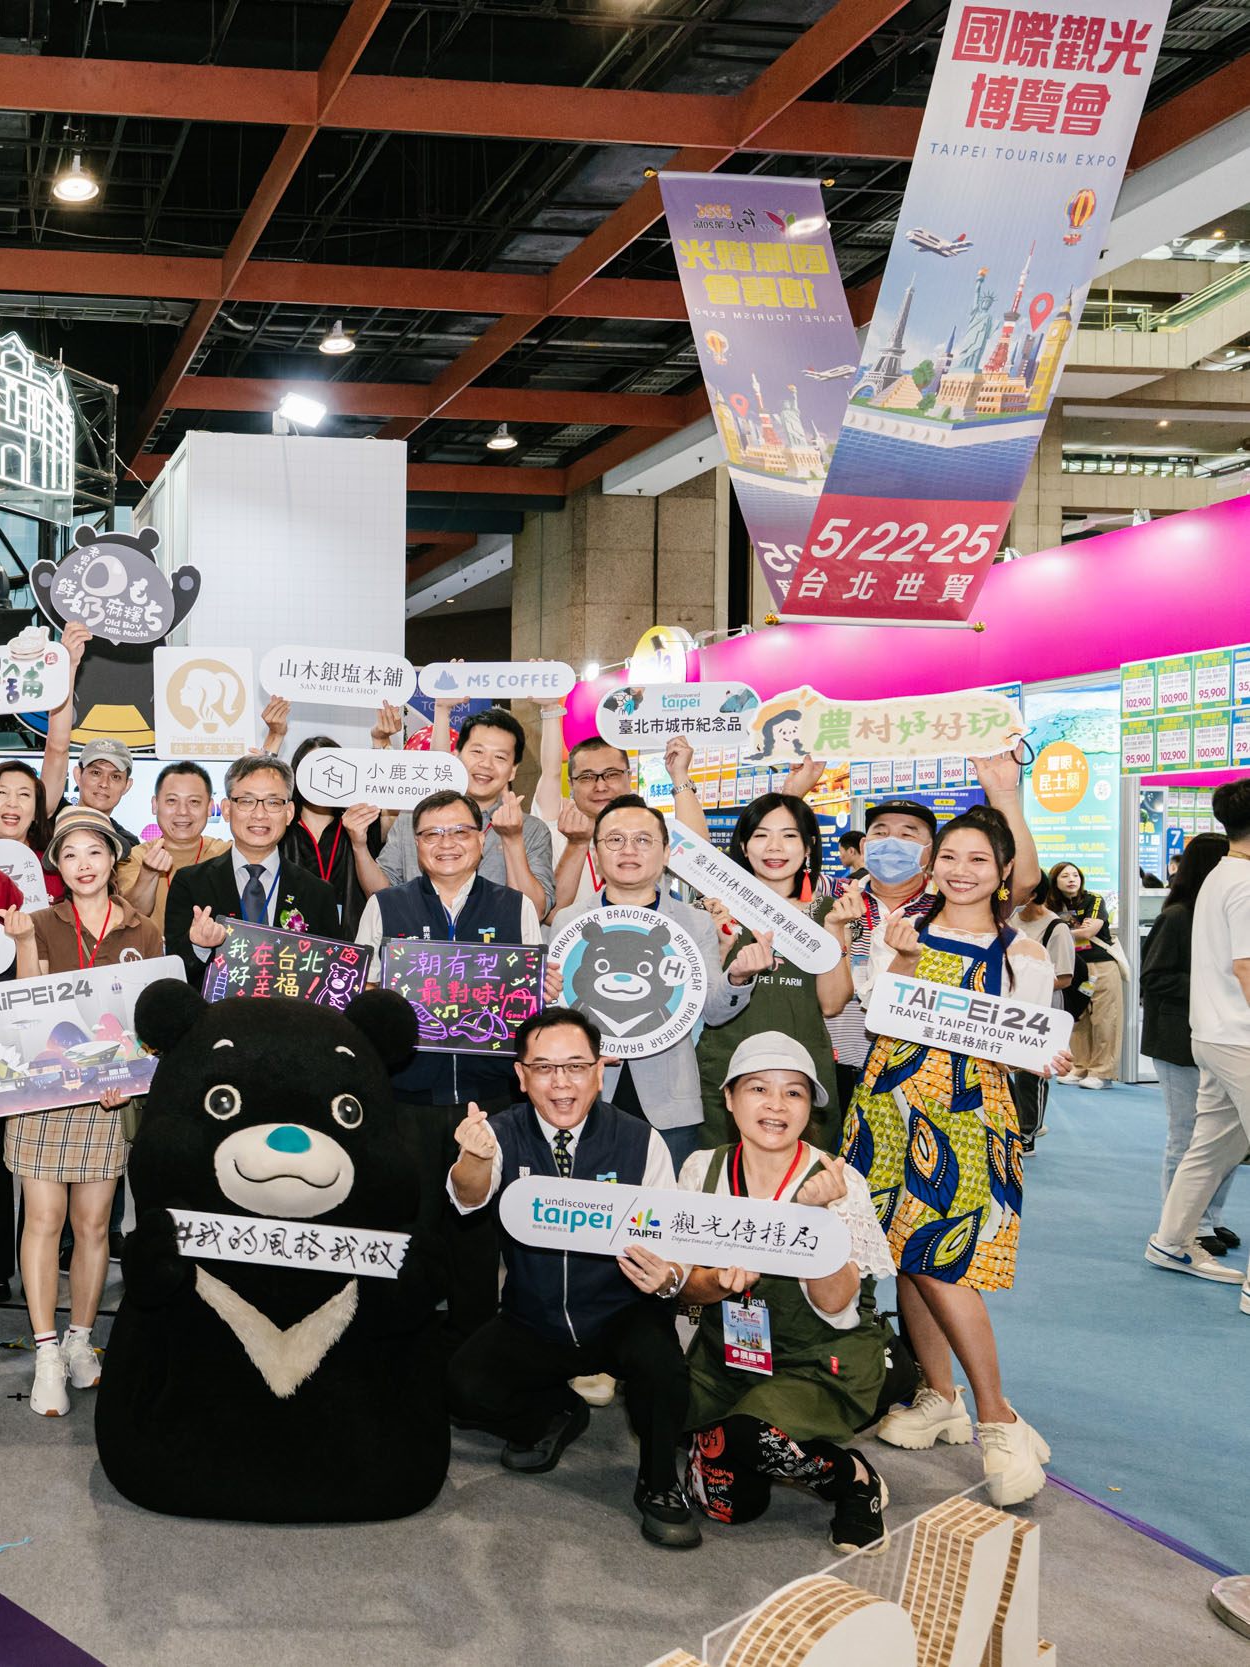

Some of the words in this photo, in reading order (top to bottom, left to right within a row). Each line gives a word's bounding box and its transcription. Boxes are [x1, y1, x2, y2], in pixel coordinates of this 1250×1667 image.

[950, 6, 1154, 75] 國際觀光
[965, 73, 1112, 136] 博覽會
[930, 142, 989, 159] TAIPEI
[995, 146, 1069, 167] TOURISM
[1075, 152, 1117, 168] EXPO
[811, 519, 999, 564] 5/22-25
[798, 568, 974, 603] 台北世貿
[468, 674, 490, 688] M5
[496, 673, 559, 688] COFFEE
[356, 687, 378, 695] SHOP
[1161, 692, 1188, 704] 100,900
[1198, 687, 1226, 699] 95,900
[662, 695, 700, 711] taipei
[1126, 697, 1151, 709] 102,900
[619, 716, 741, 735] 臺北市城市紀念品
[813, 708, 1011, 750] 農村好好玩
[1125, 753, 1150, 764] 95,900
[1160, 750, 1186, 761] 102,900
[1197, 747, 1225, 758] 100,900
[367, 763, 453, 782] 小鹿文娛
[365, 785, 394, 794] FAWN
[398, 786, 430, 796] GROUP
[406, 951, 500, 980] 潮有型
[664, 960, 686, 980] Hi
[779, 977, 802, 986] FARM
[889, 1004, 934, 1024] TRAVEL
[938, 1015, 978, 1033] TAIPEI
[981, 1025, 1014, 1042] YOUR
[1019, 1034, 1048, 1049] WAY
[922, 1026, 1003, 1054] 臺北風格旅行
[545, 1198, 613, 1212] undiscovered
[532, 1198, 612, 1233] taipei
[627, 1227, 662, 1239] TAIPEI
[670, 1211, 818, 1250] 觀光傳播局
